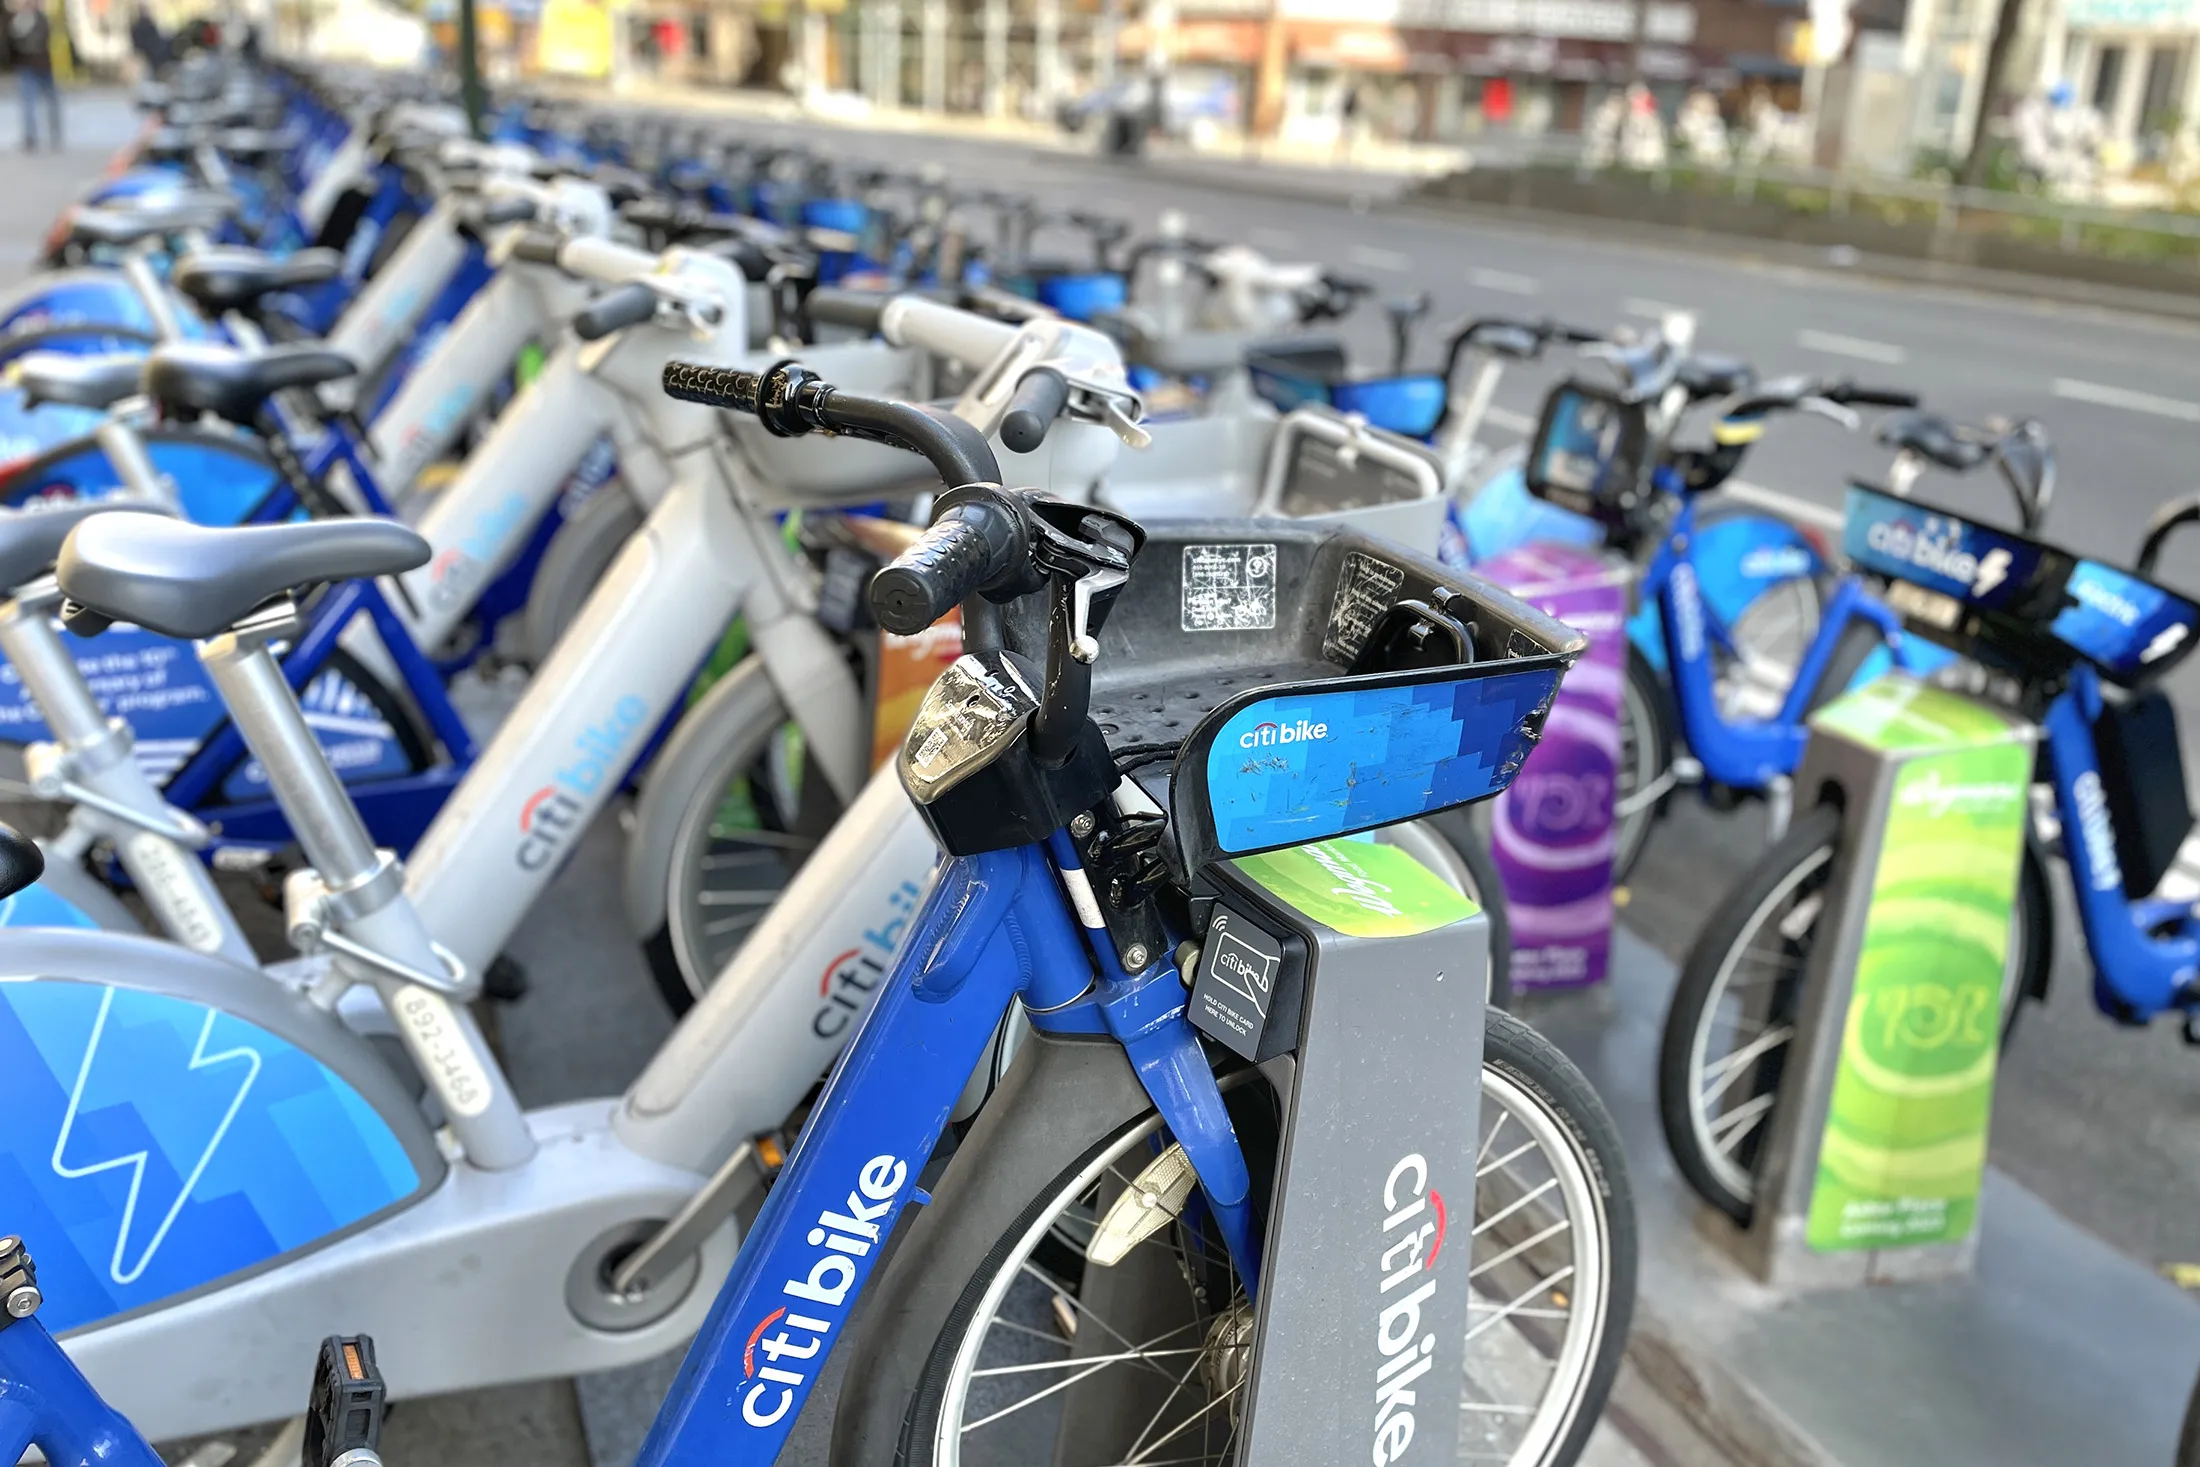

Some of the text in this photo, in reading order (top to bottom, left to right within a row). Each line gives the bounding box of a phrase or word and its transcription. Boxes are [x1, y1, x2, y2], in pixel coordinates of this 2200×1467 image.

[1239, 719, 1328, 748] citi bike
[515, 784, 582, 872] citi
[1220, 952, 1239, 971] citi
[811, 948, 886, 1038] citi
[1203, 993, 1254, 1029] HOLD CITI BIKE CARD
[1204, 1005, 1247, 1036] HERE TO UNLOCK
[741, 1154, 907, 1428] citi bike
[1372, 1153, 1448, 1467] citi bike
